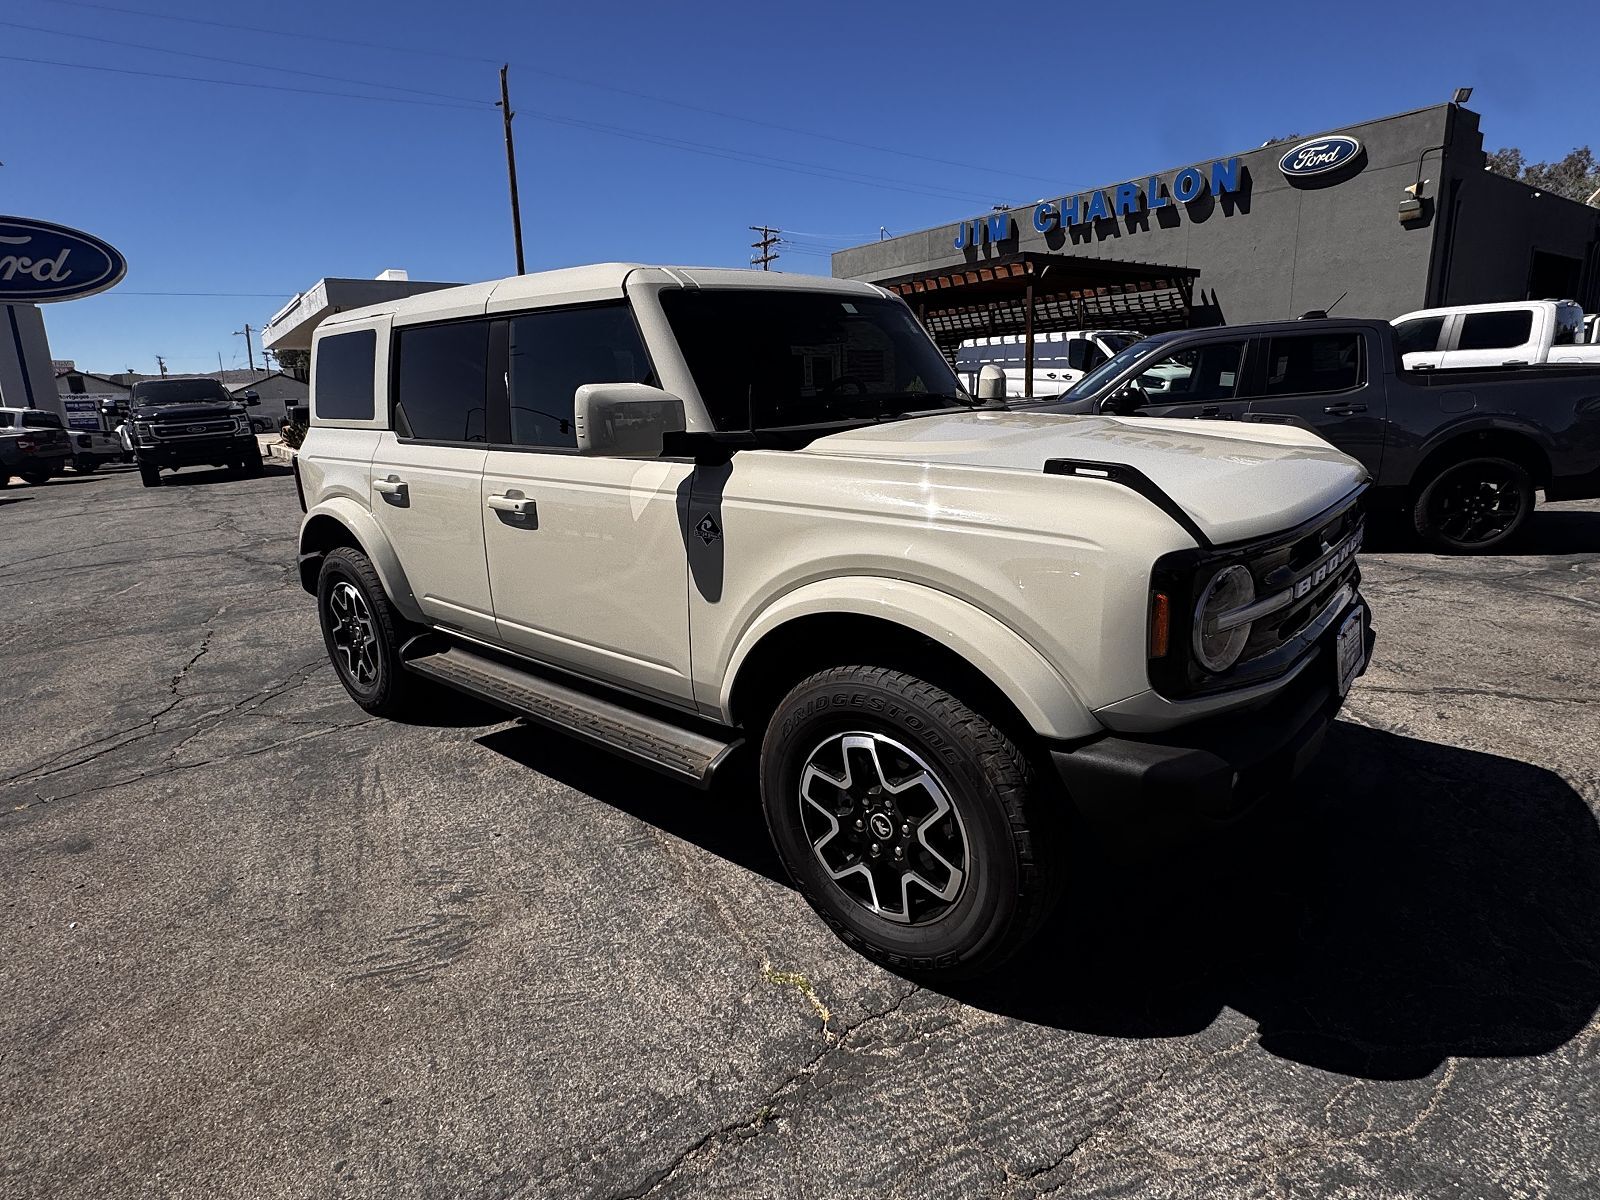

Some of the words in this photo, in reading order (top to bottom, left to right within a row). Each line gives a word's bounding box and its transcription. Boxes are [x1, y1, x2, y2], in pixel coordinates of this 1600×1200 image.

[1293, 144, 1341, 170] Ford
[954, 213, 1012, 250] JIM
[1033, 158, 1241, 233] CHARLON
[0, 235, 72, 282] rd
[780, 693, 963, 766] BRIDGESTONE
